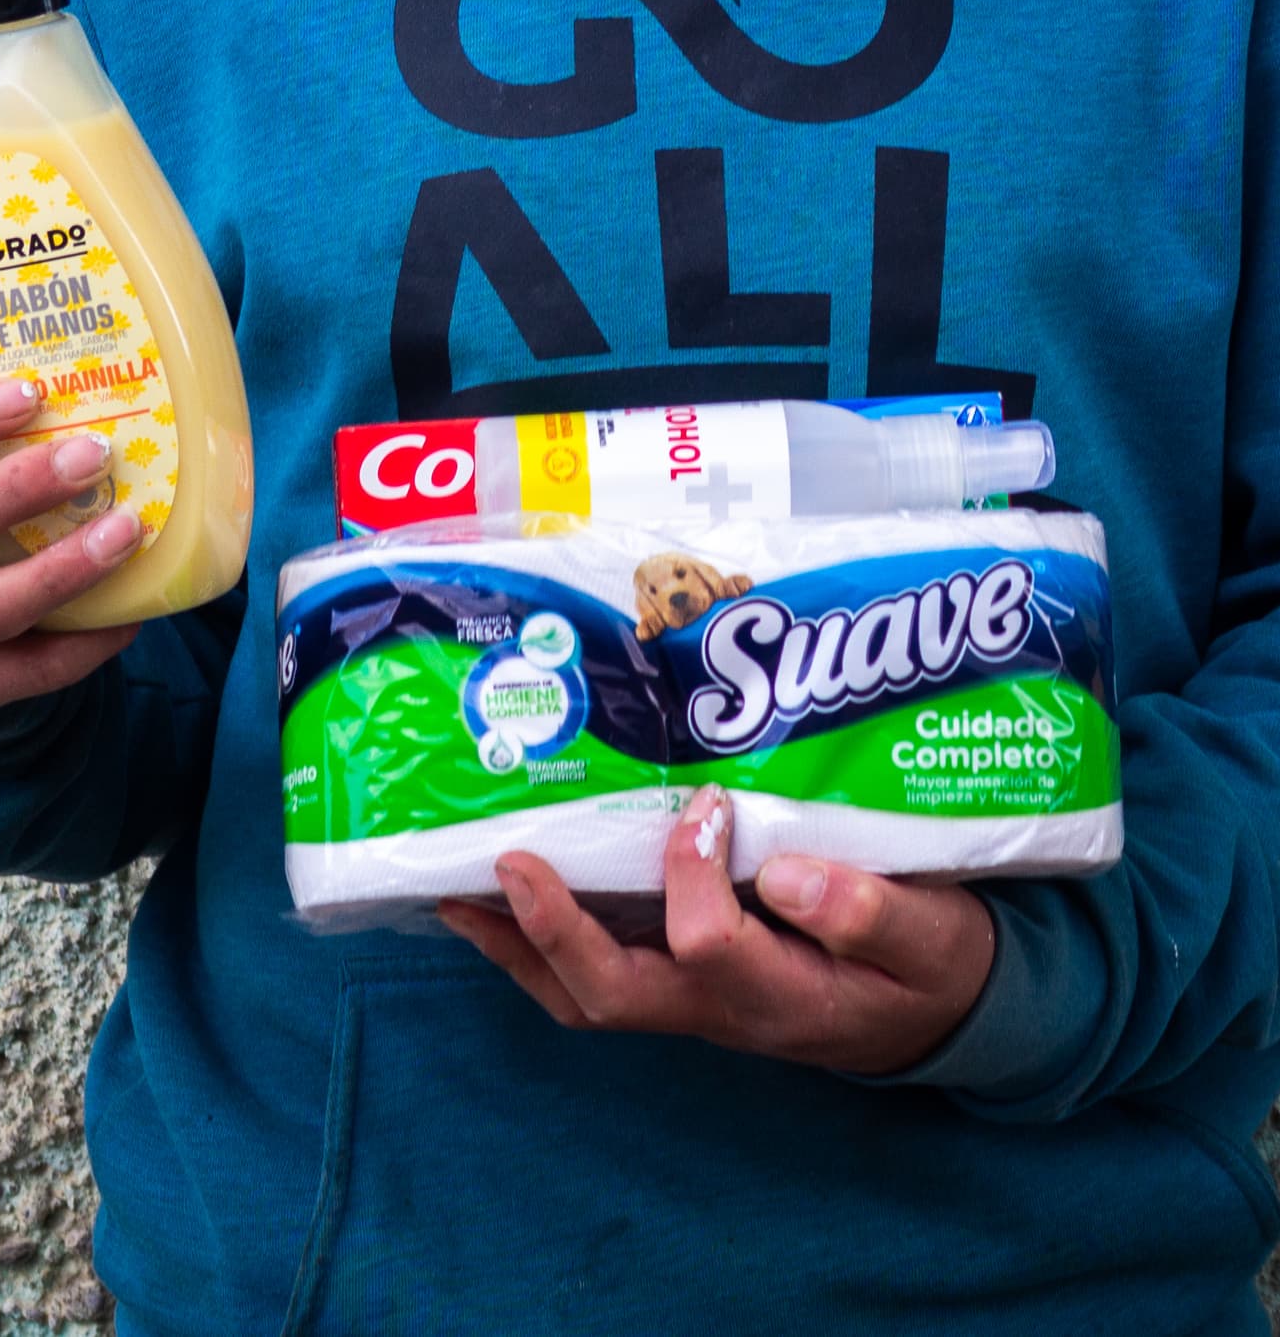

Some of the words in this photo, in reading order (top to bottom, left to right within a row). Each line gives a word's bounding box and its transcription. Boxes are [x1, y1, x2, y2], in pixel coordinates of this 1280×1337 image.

[17, 303, 114, 345] MANOS
[51, 357, 159, 397] VAINILLA
[458, 625, 514, 644] FRESCA
[690, 560, 1032, 749] Suave
[486, 687, 561, 707] HIGIENE
[487, 701, 563, 720] COMPLETA
[915, 709, 1054, 740] Cuidado
[891, 740, 1056, 774] Completo
[903, 773, 952, 791] Mayor
[906, 789, 974, 806] limpieza
[992, 790, 1053, 805] frescura
